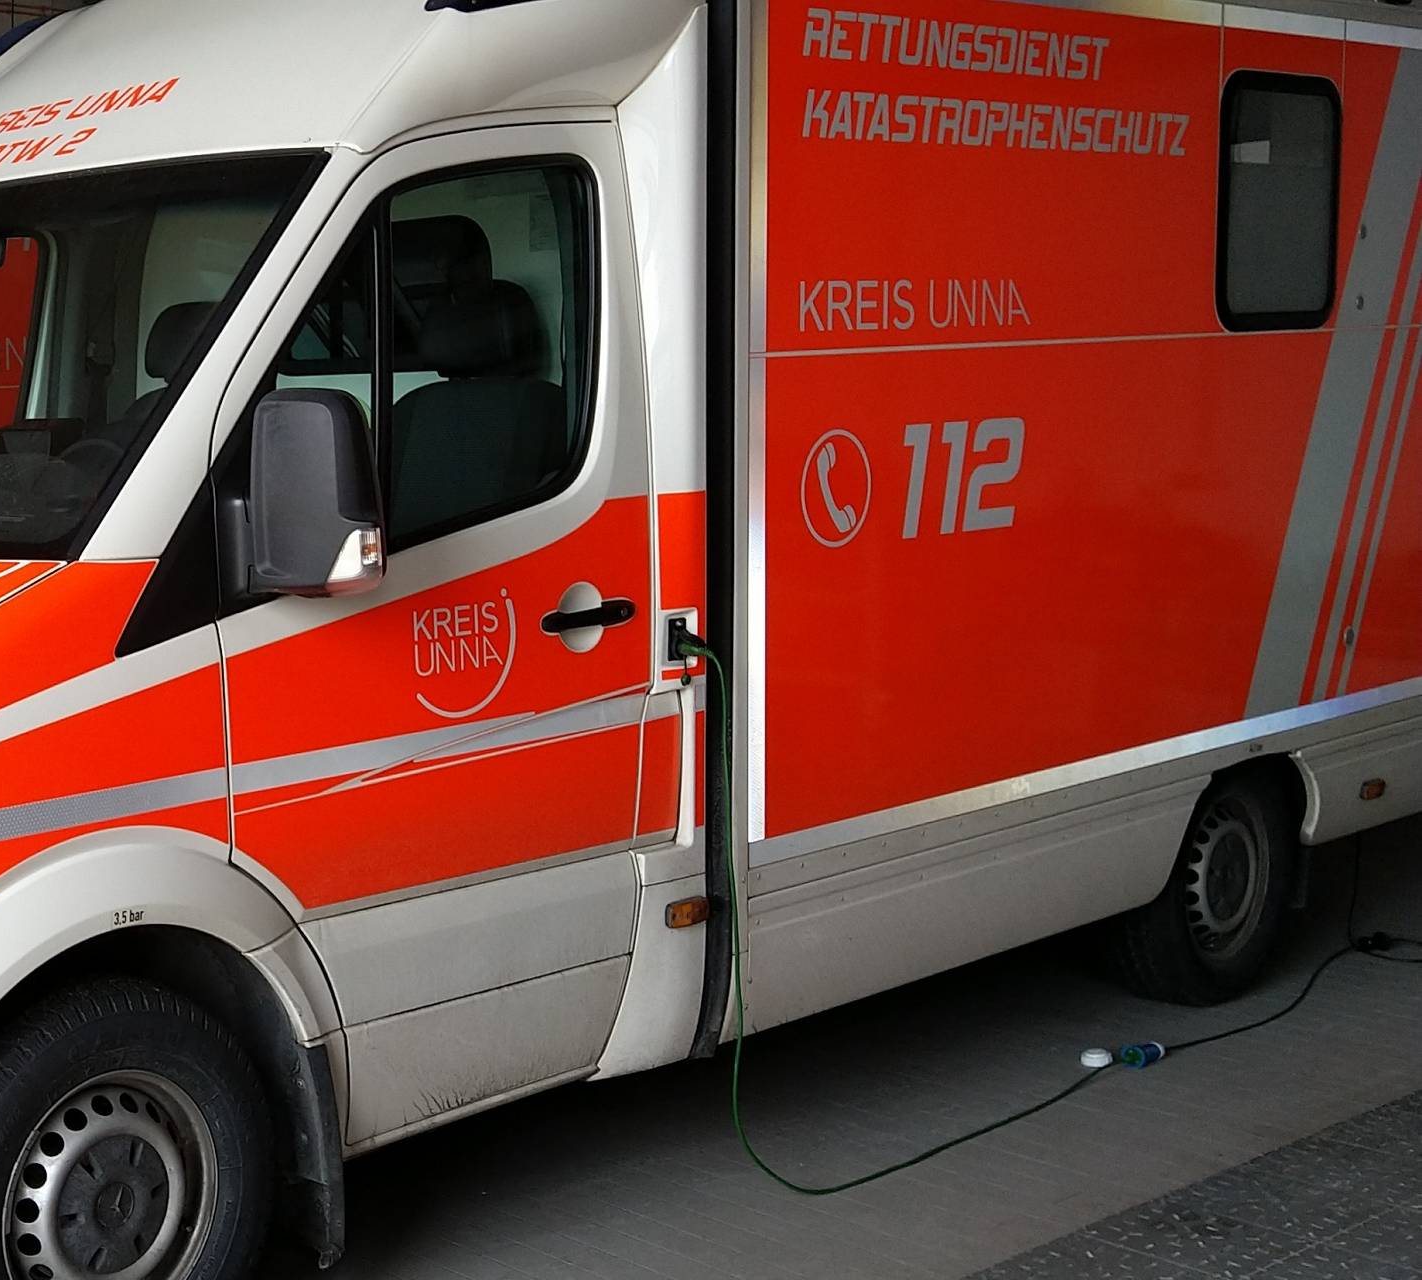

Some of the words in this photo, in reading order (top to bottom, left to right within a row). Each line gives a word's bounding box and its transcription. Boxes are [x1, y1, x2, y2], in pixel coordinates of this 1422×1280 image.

[803, 8, 1110, 81] RETTUNGSDIENST
[65, 77, 180, 121] UNNA
[53, 127, 98, 156] 2
[802, 89, 1190, 157] KATASTROPHENSCHUTZ
[799, 279, 915, 332] KREIS
[929, 279, 1031, 329] UNNA
[902, 416, 1025, 539] 112
[412, 601, 499, 642] KREIS
[414, 634, 504, 677] UNNA
[129, 909, 145, 923] bar
